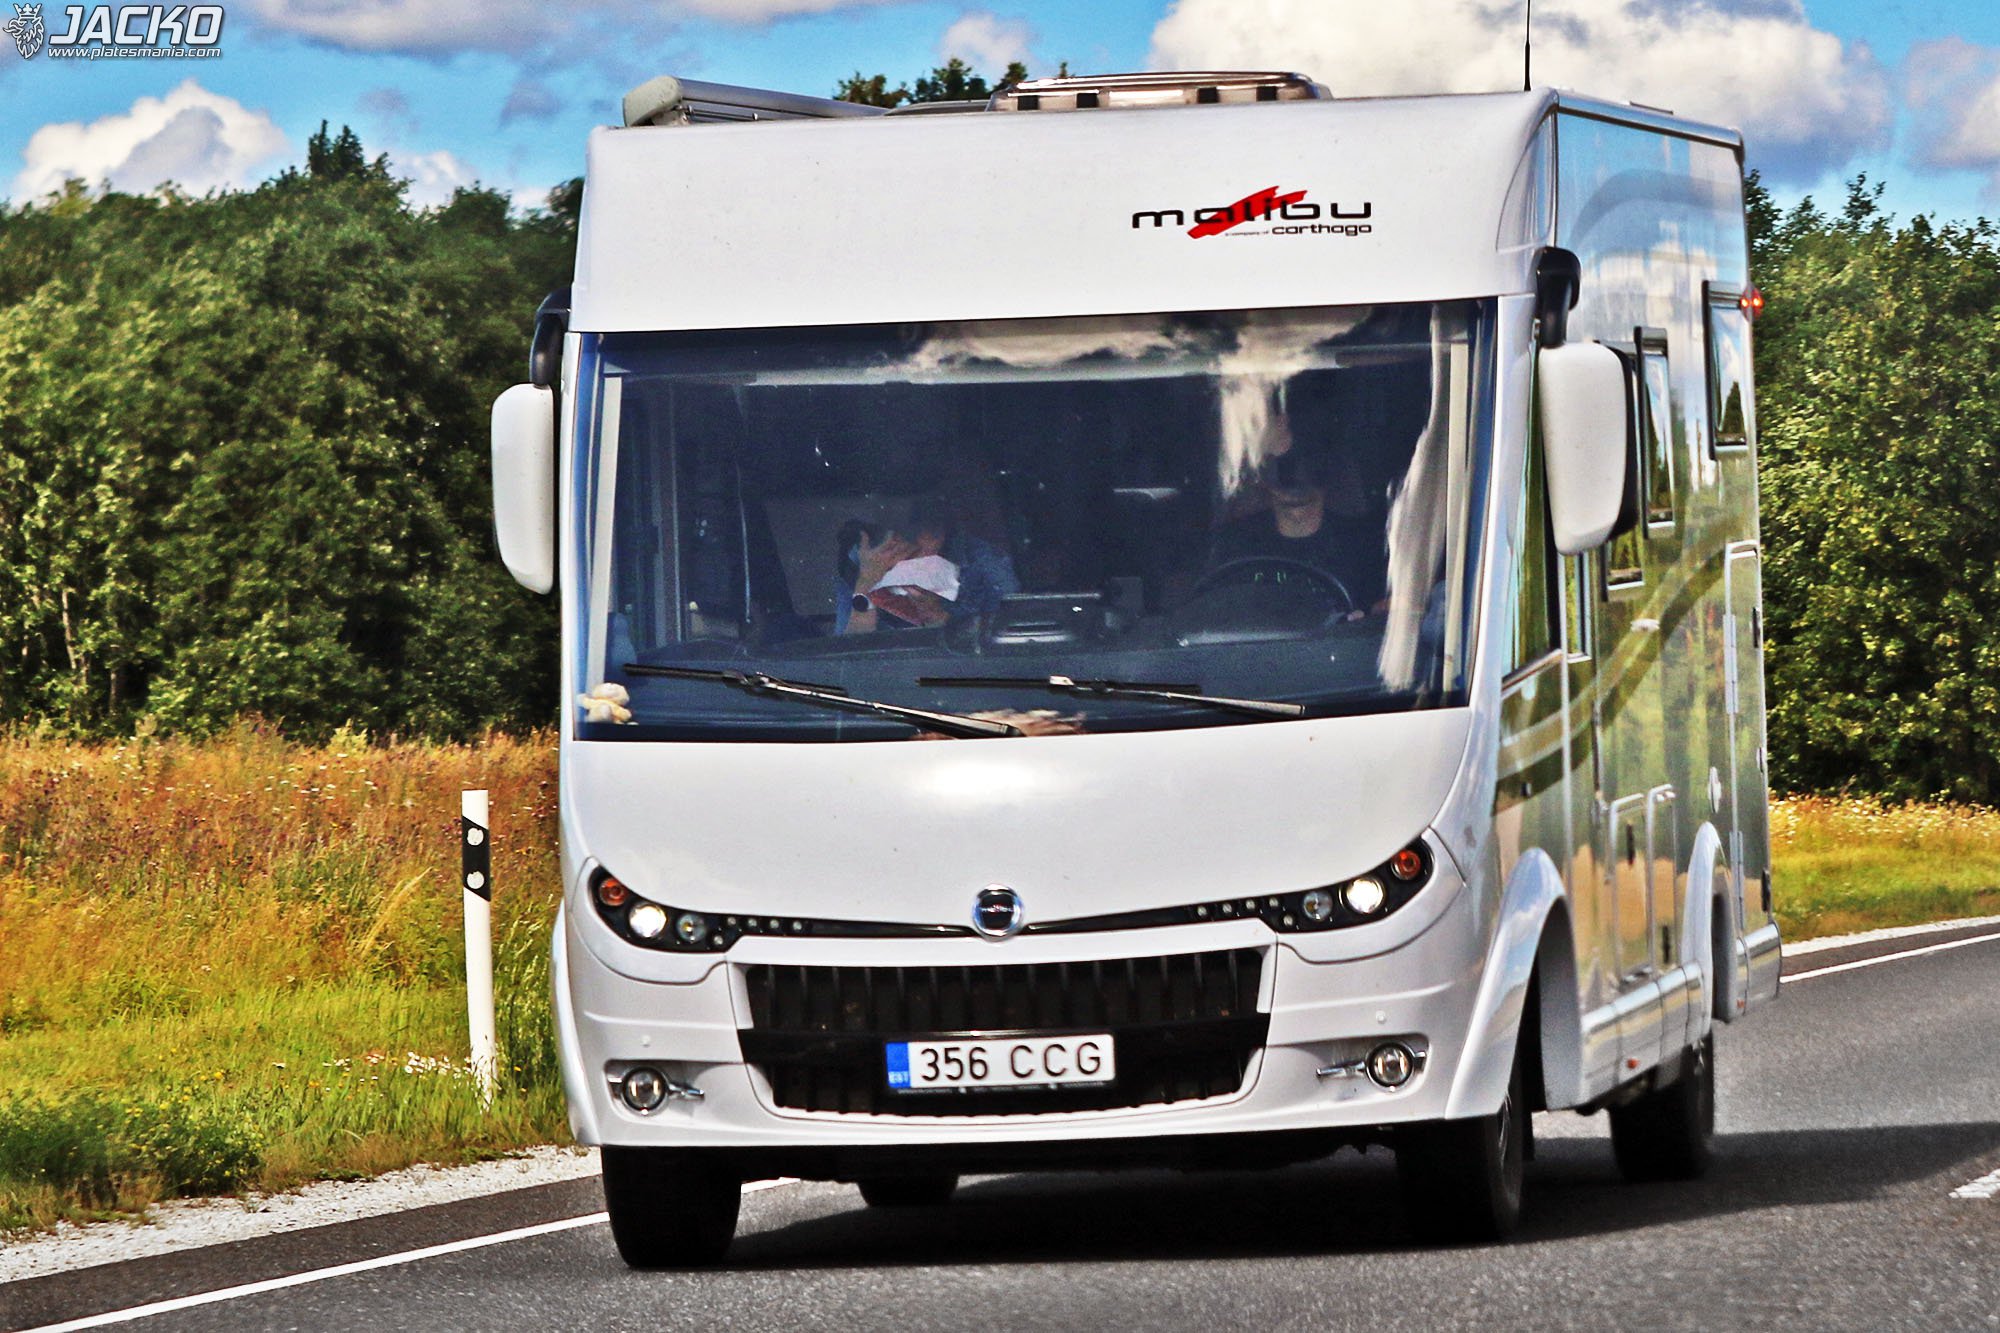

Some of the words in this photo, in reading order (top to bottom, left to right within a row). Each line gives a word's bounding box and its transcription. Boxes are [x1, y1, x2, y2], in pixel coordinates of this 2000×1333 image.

[1132, 197, 1372, 229] malibu
[1272, 223, 1372, 237] carthago
[920, 1047, 989, 1082] 356
[1010, 1041, 1102, 1079] CCG
